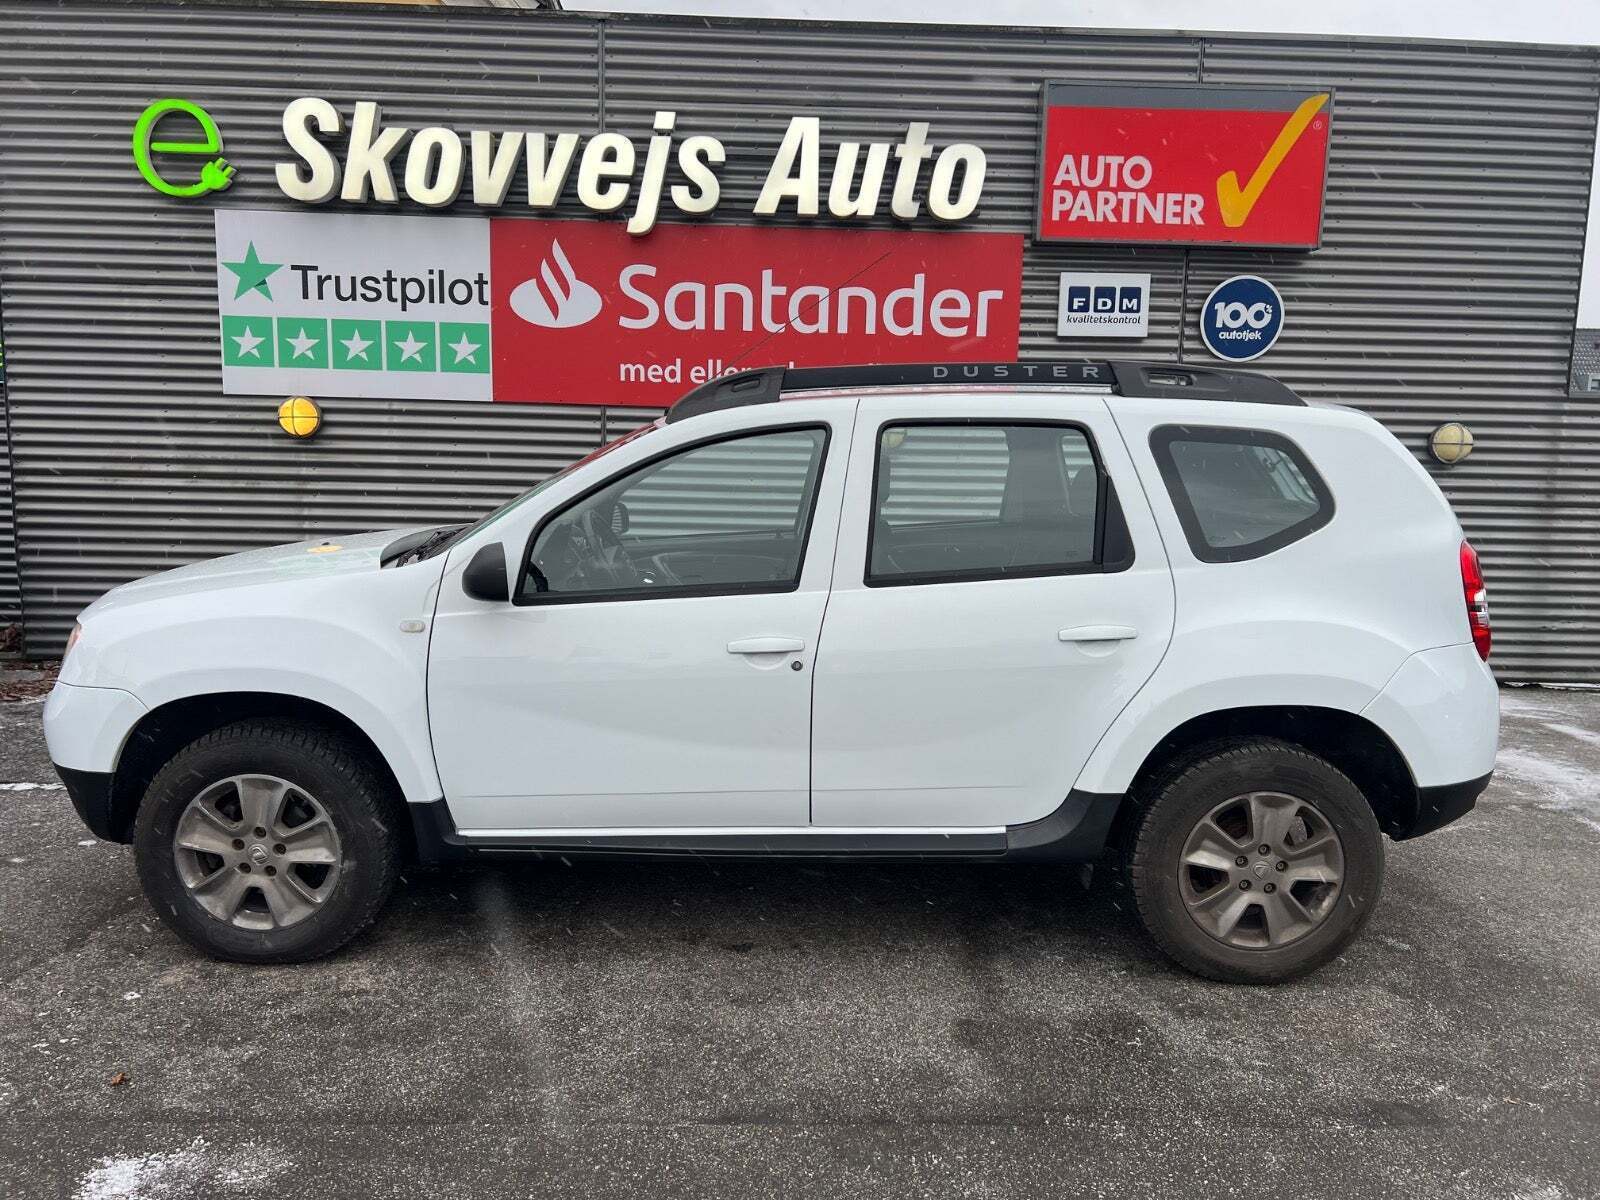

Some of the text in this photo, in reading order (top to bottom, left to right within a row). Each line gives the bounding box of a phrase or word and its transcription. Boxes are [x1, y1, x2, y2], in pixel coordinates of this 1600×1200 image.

[275, 98, 726, 235] Skovvejs
[753, 117, 988, 221] Auto
[1053, 155, 1152, 189] AUTO
[1051, 190, 1204, 225] PARTNER
[291, 265, 490, 311] Trustpilot
[618, 264, 1003, 337] Santander
[1072, 297, 1138, 311] FDM
[1066, 315, 1141, 325] kvalitetskontrol
[1218, 330, 1262, 341] autotjek
[619, 358, 751, 384] med ell
[933, 365, 1099, 379] DUSTER
